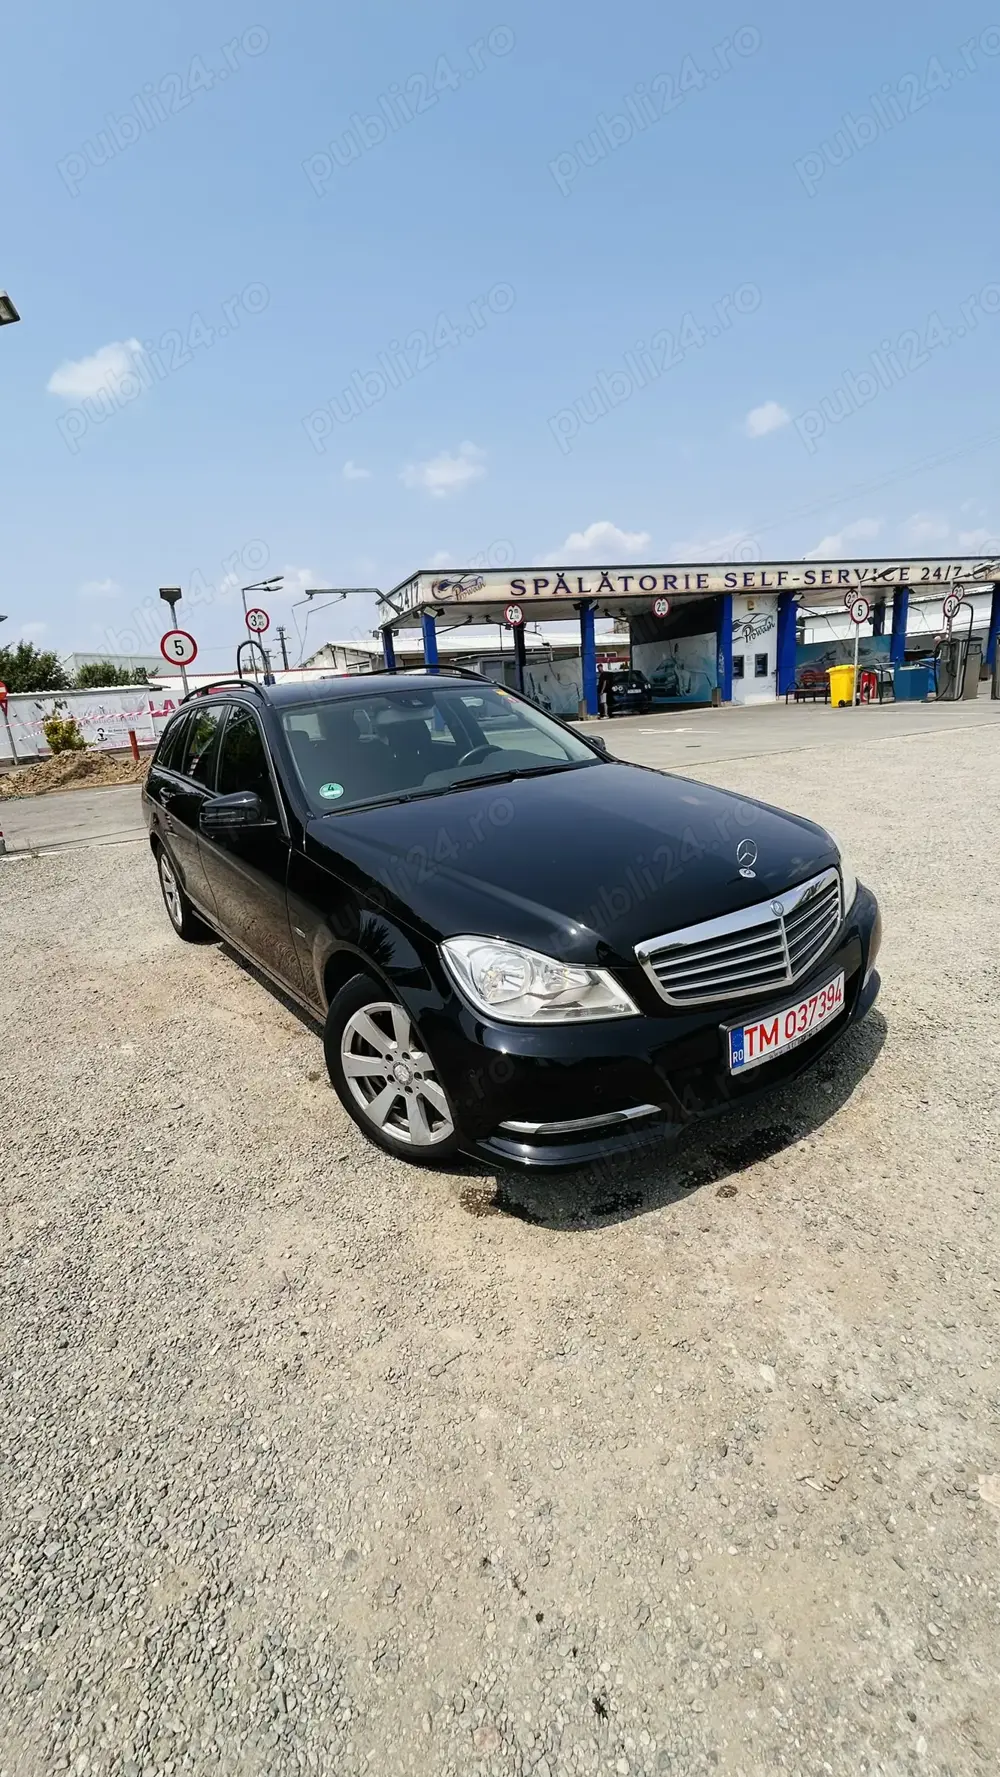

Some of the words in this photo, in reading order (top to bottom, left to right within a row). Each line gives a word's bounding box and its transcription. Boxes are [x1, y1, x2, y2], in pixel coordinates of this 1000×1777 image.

[510, 571, 709, 596] SPĂLĂTORIE
[724, 567, 910, 588] SELF-SERVICE
[921, 565, 962, 581] 24/7
[508, 609, 515, 620] 2
[857, 604, 863, 617] 5
[250, 614, 258, 627] 3
[173, 639, 185, 657] 5
[327, 784, 335, 792] 4
[744, 1017, 779, 1057] TM
[784, 977, 842, 1039] 037394
[732, 1049, 744, 1063] RO
